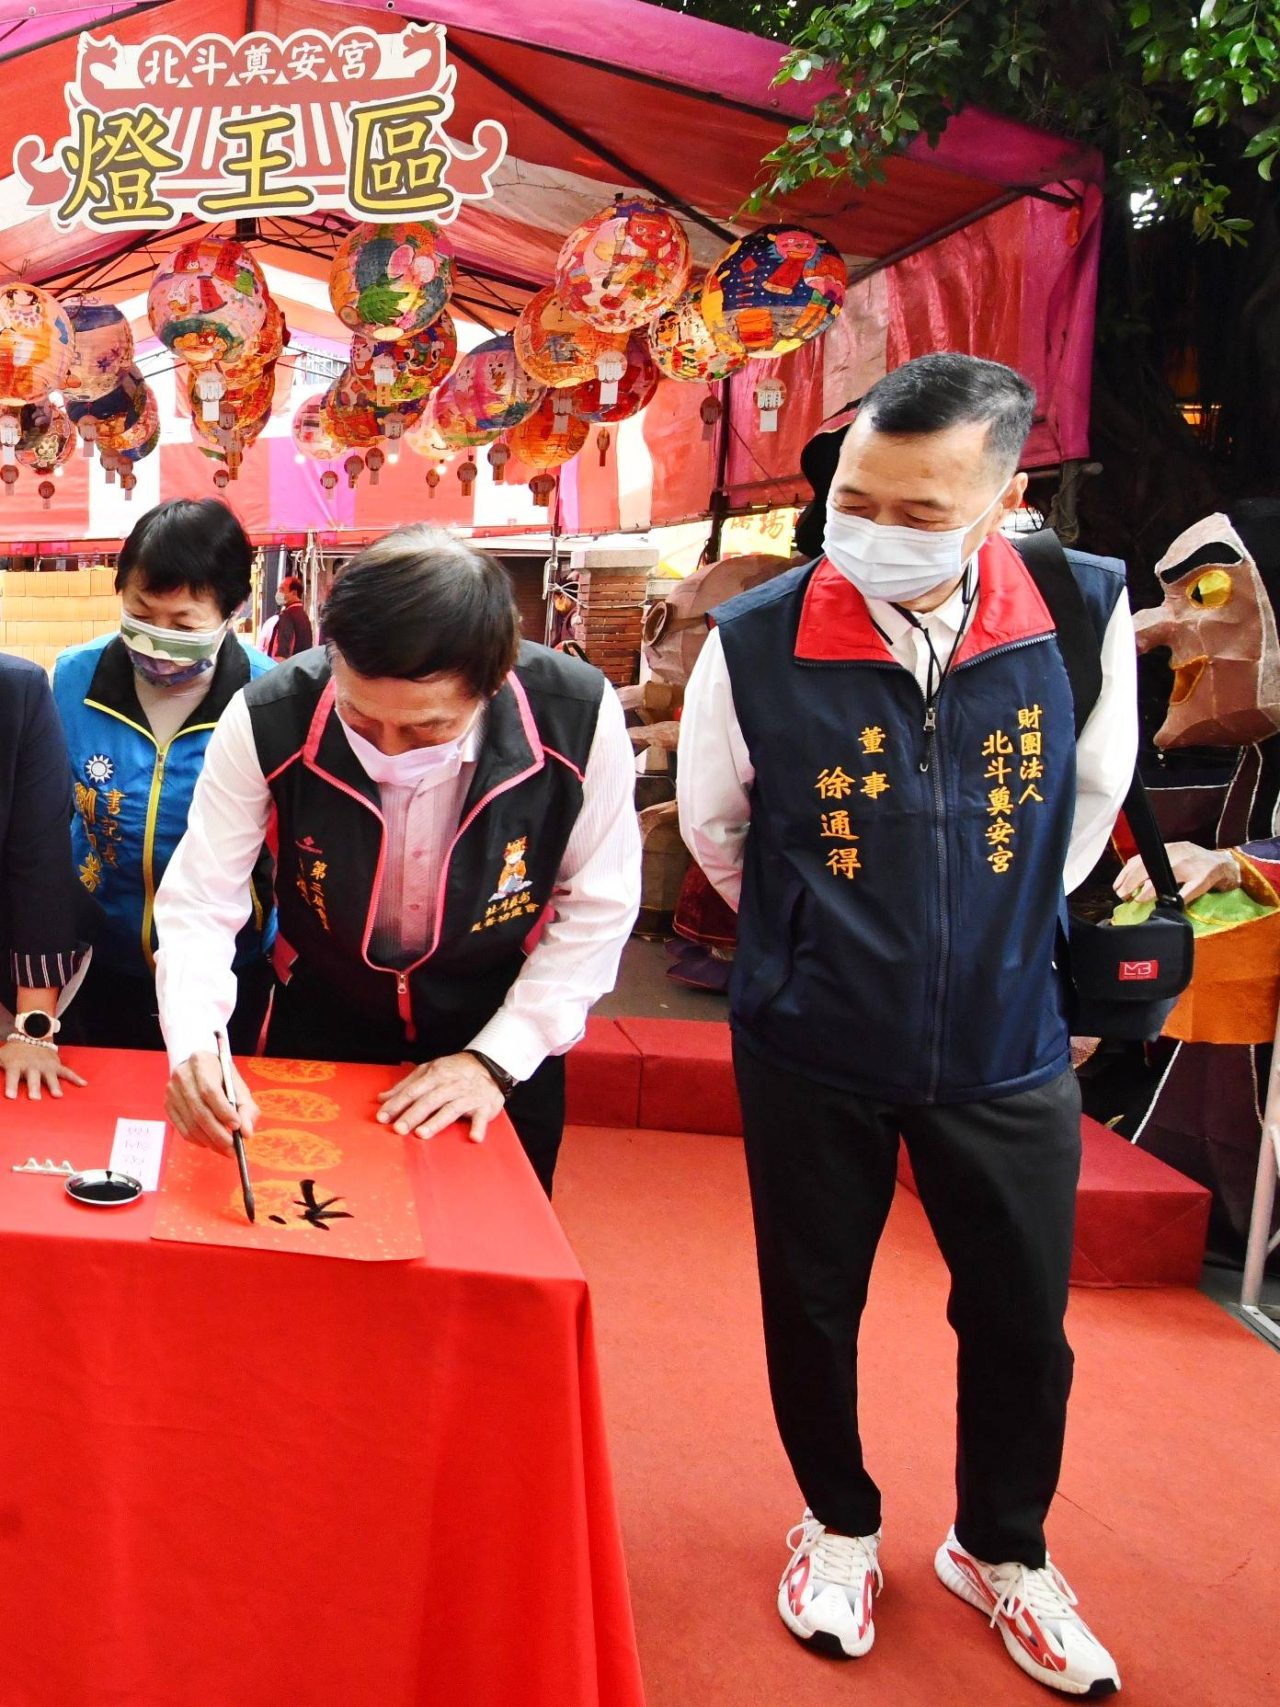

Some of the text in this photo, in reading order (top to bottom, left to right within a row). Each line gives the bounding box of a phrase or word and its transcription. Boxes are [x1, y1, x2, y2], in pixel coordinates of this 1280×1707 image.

[143, 39, 375, 86] 北斗奠安宮
[59, 95, 456, 224] 燈王區
[858, 726, 890, 799] 董事
[981, 730, 1015, 874] 北斗奠安宮
[1017, 703, 1045, 805] 財團法人
[814, 766, 862, 880] 徐通得
